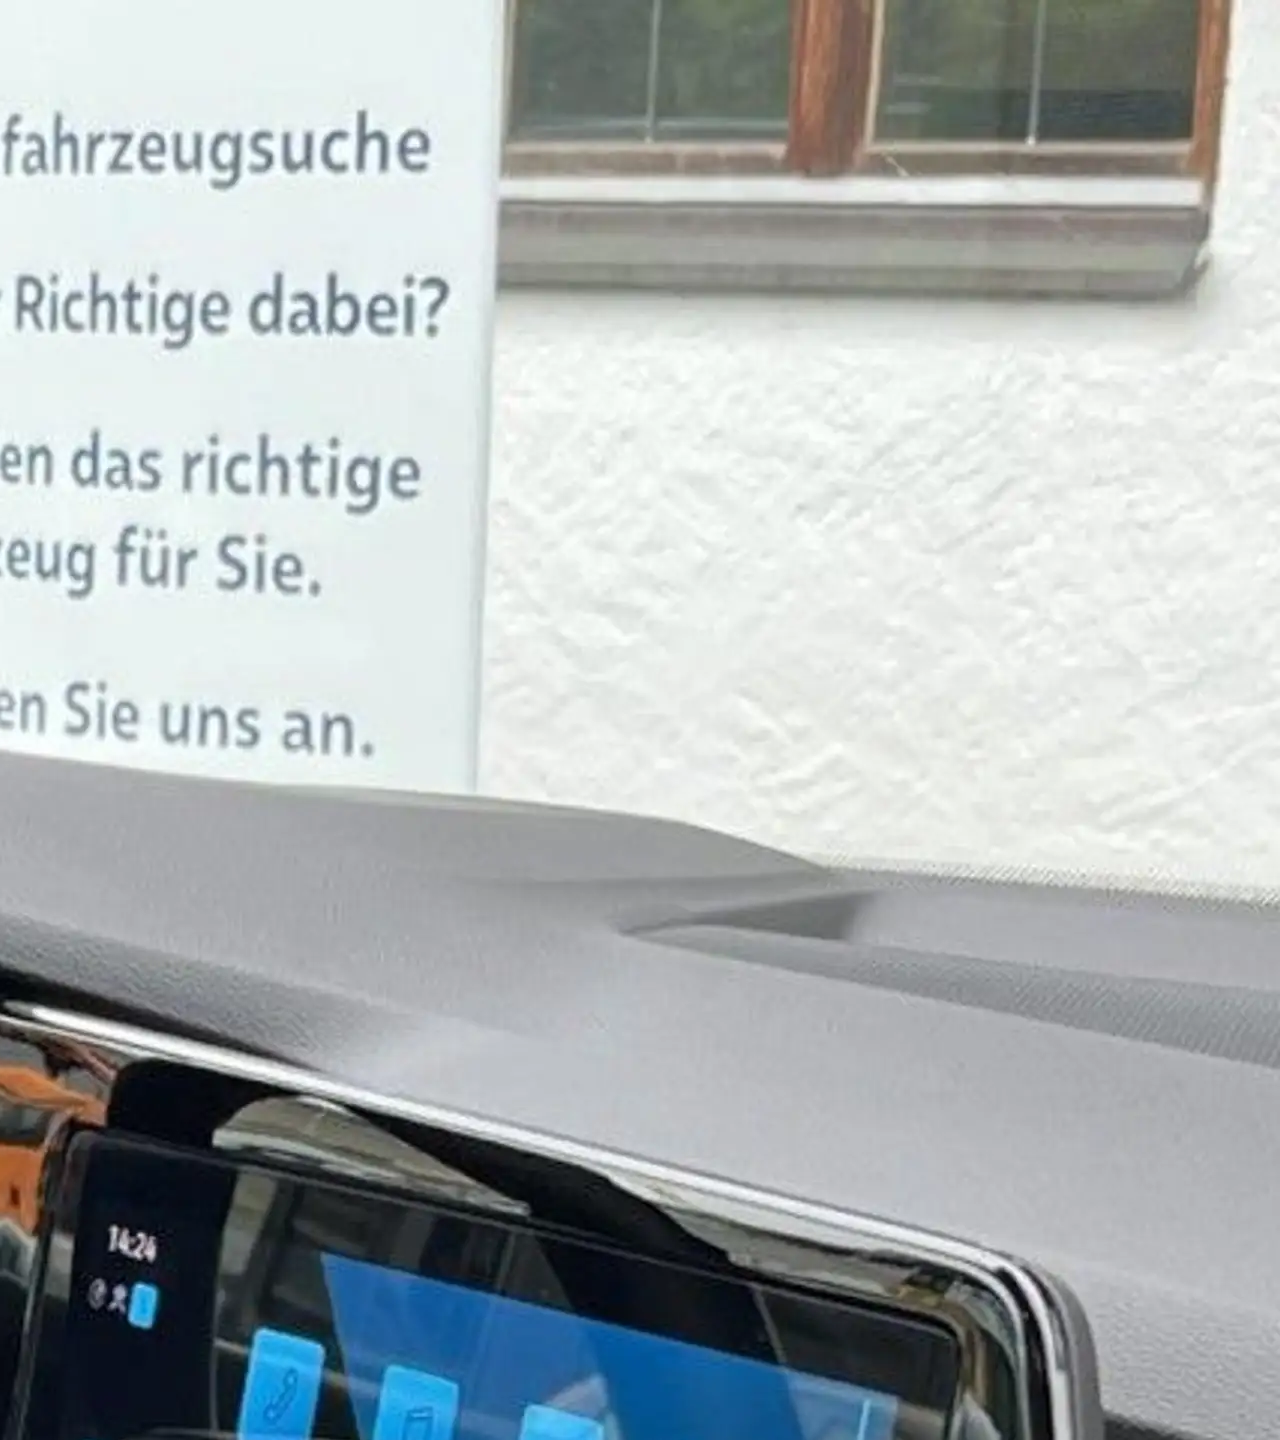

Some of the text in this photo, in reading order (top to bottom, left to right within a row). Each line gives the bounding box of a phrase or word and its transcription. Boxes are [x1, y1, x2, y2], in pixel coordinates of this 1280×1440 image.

[14, 273, 230, 349] Richtige
[247, 272, 449, 337] dabei?
[70, 431, 162, 492] das
[182, 435, 422, 515] richtige
[116, 525, 197, 590] für
[216, 534, 321, 598] Sie.
[64, 680, 140, 741] Sie
[159, 702, 261, 750] uns
[282, 707, 374, 757] an.
